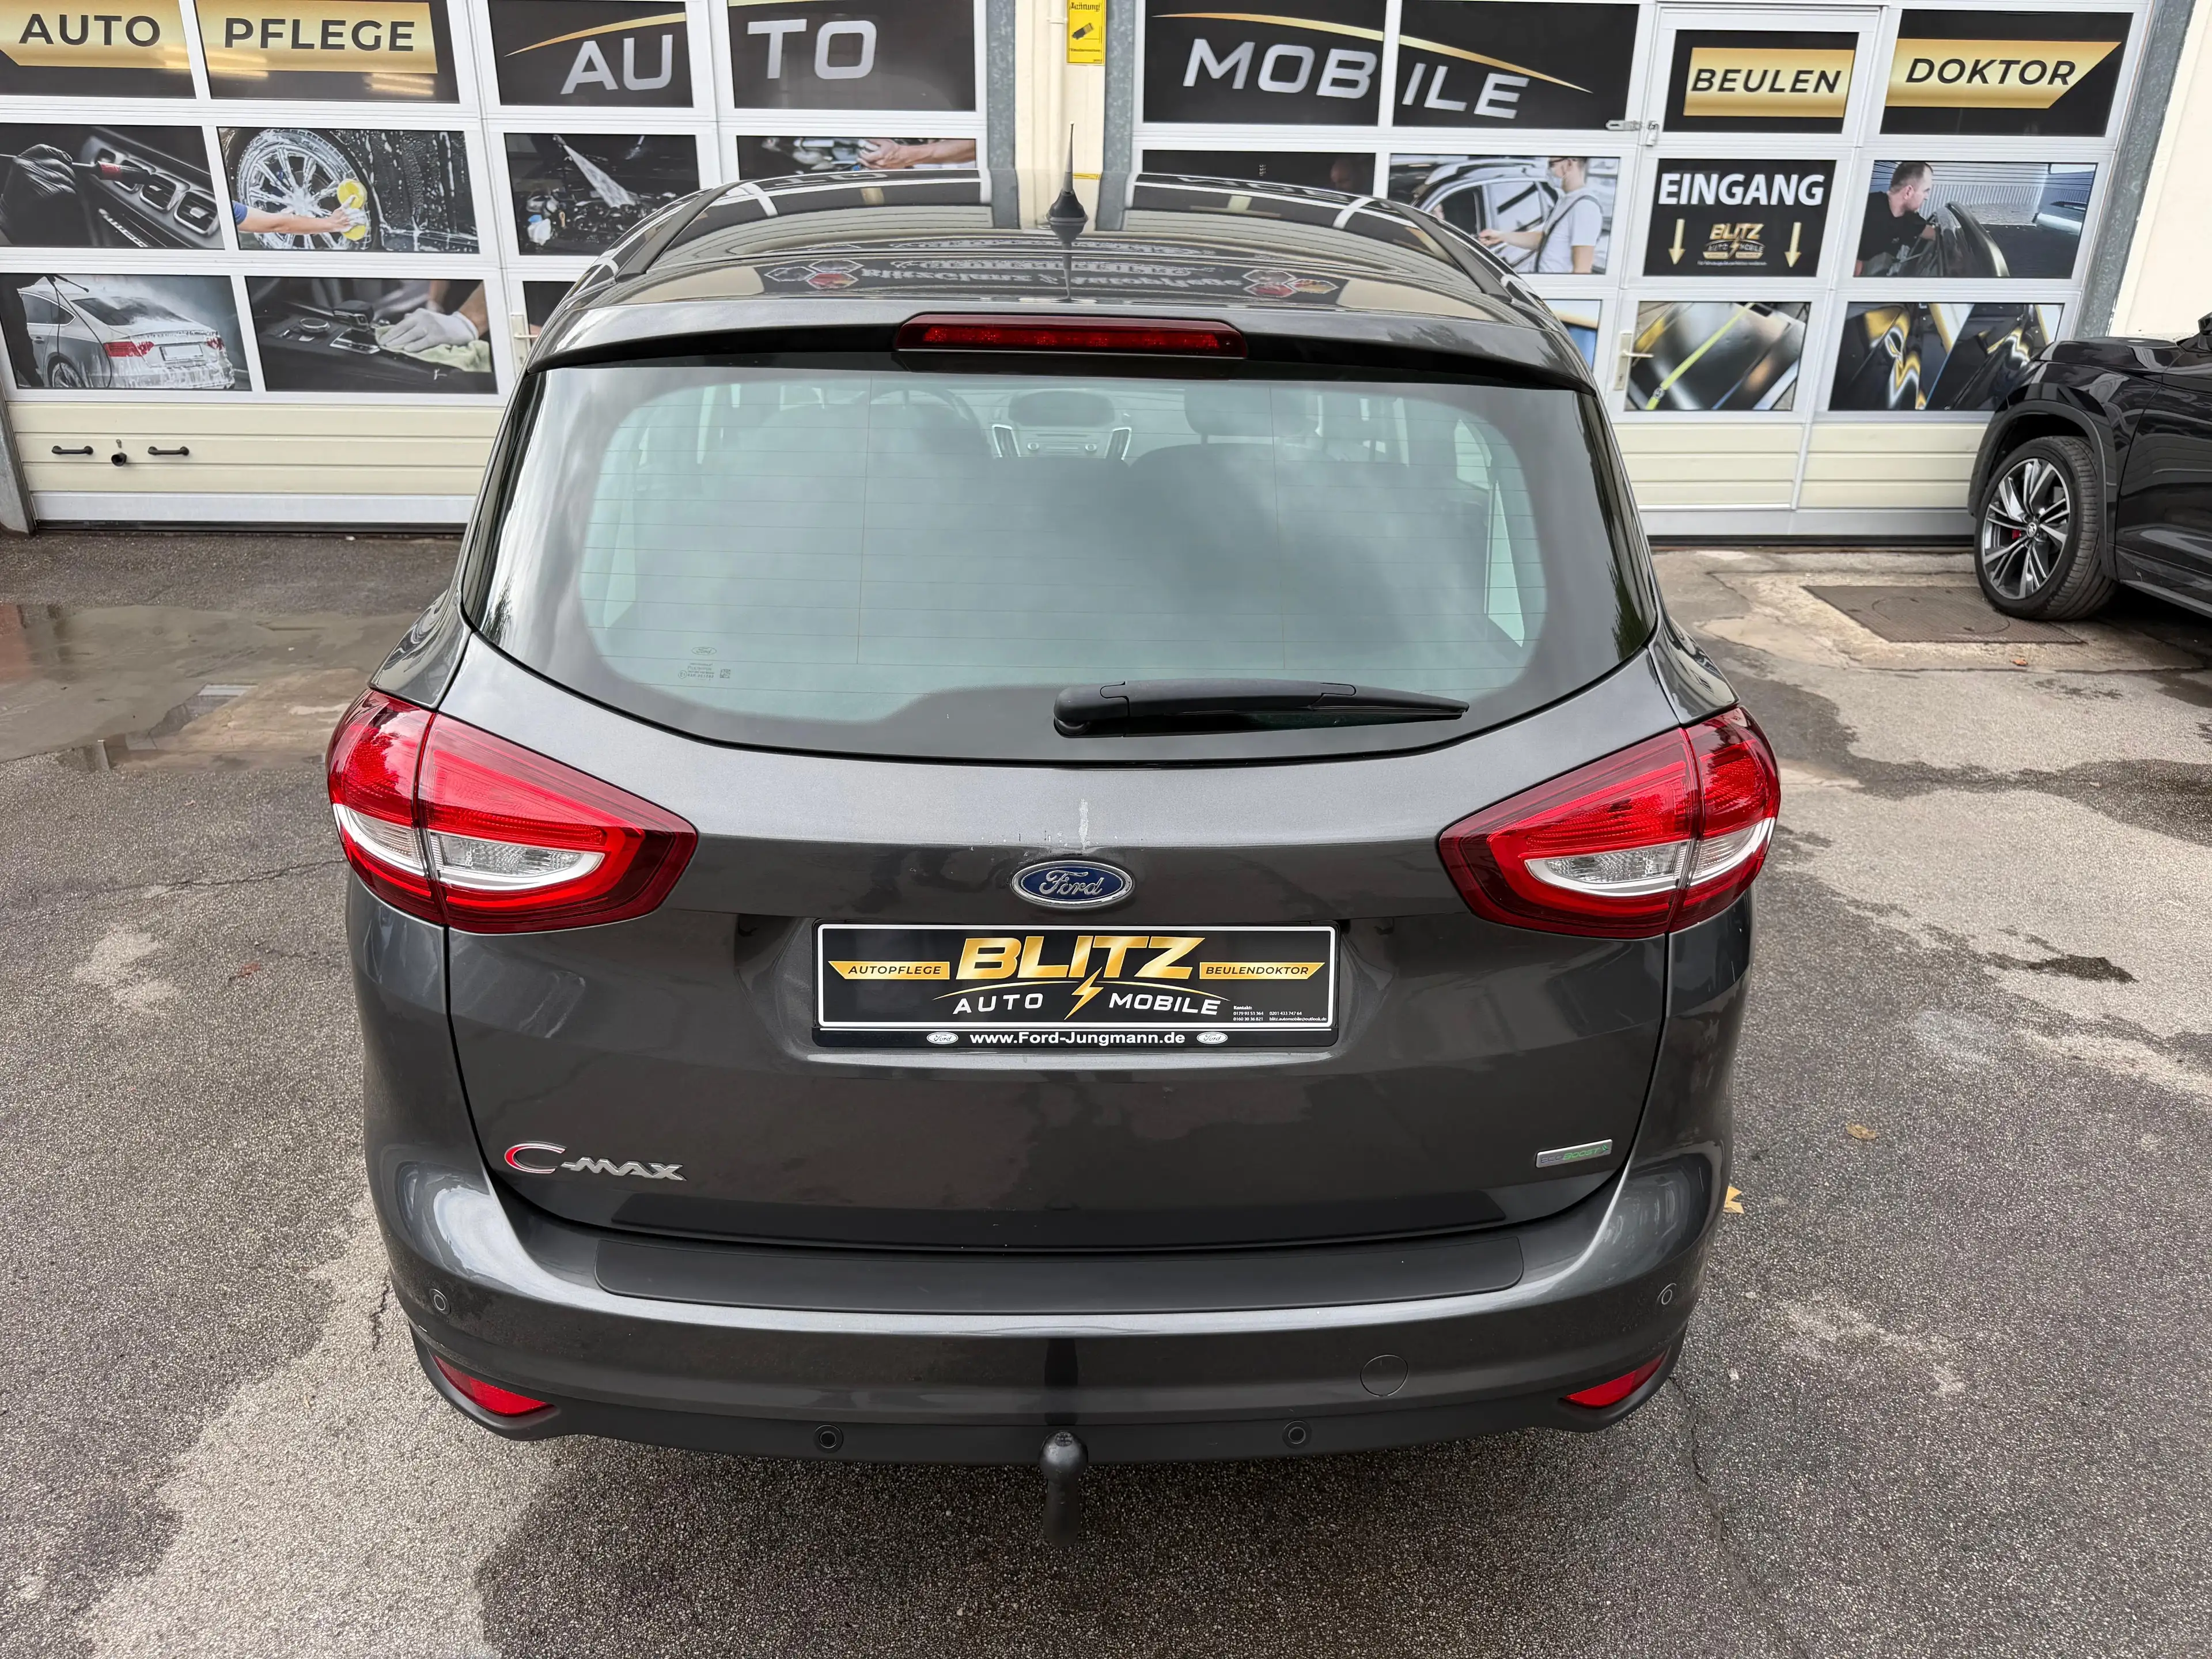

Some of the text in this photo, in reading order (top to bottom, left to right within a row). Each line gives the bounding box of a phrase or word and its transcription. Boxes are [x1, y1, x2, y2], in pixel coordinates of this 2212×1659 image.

[19, 14, 415, 51] AUTO PFLEGE
[1691, 58, 2076, 93] BEULEN DOKTOR
[1658, 173, 1824, 205] EINGANG
[1709, 223, 1764, 240] BLITZ
[1039, 870, 1104, 895] Ford
[956, 935, 1205, 979] BLITZ
[847, 965, 941, 975] AUTOPFLEGE
[1205, 967, 1309, 975] BEULENDOKTOR
[953, 993, 1221, 1016] AUTO MOBILE
[969, 1031, 1185, 1047] www.Ford-Jungmann.de
[1203, 1033, 1222, 1041] Ford
[505, 1141, 687, 1181] C-MAX
